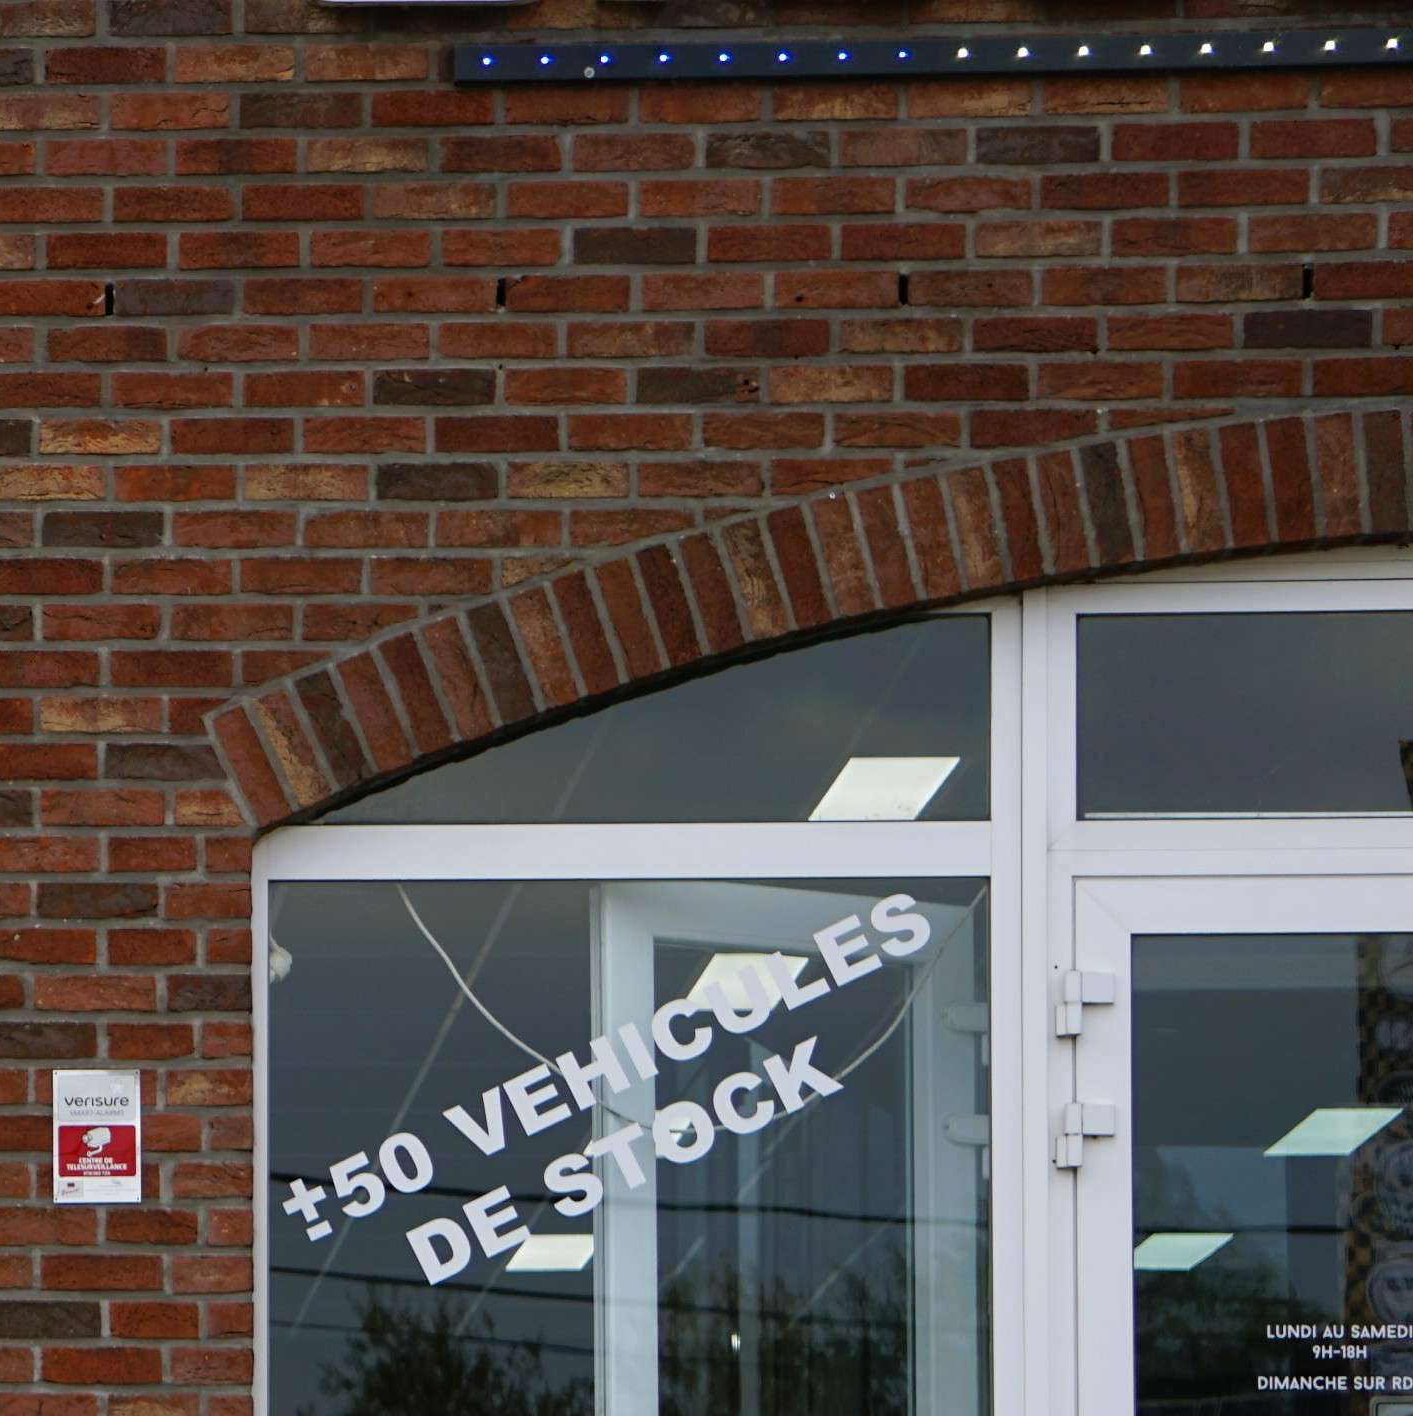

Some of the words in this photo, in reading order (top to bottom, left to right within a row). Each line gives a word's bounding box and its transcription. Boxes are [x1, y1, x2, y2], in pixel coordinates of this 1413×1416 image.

[442, 893, 931, 1157] VEHICULES
[64, 1096, 129, 1107] verisure
[405, 1185, 532, 1286] DE
[543, 1035, 844, 1218] STOCK
[1266, 1325, 1317, 1339] LUNDI
[1323, 1325, 1345, 1339] AU
[1351, 1325, 1413, 1339] SAMEDI
[1312, 1345, 1367, 1359] 9H-18H
[1257, 1376, 1348, 1390] DIMANCHE
[1354, 1376, 1386, 1390] SUR
